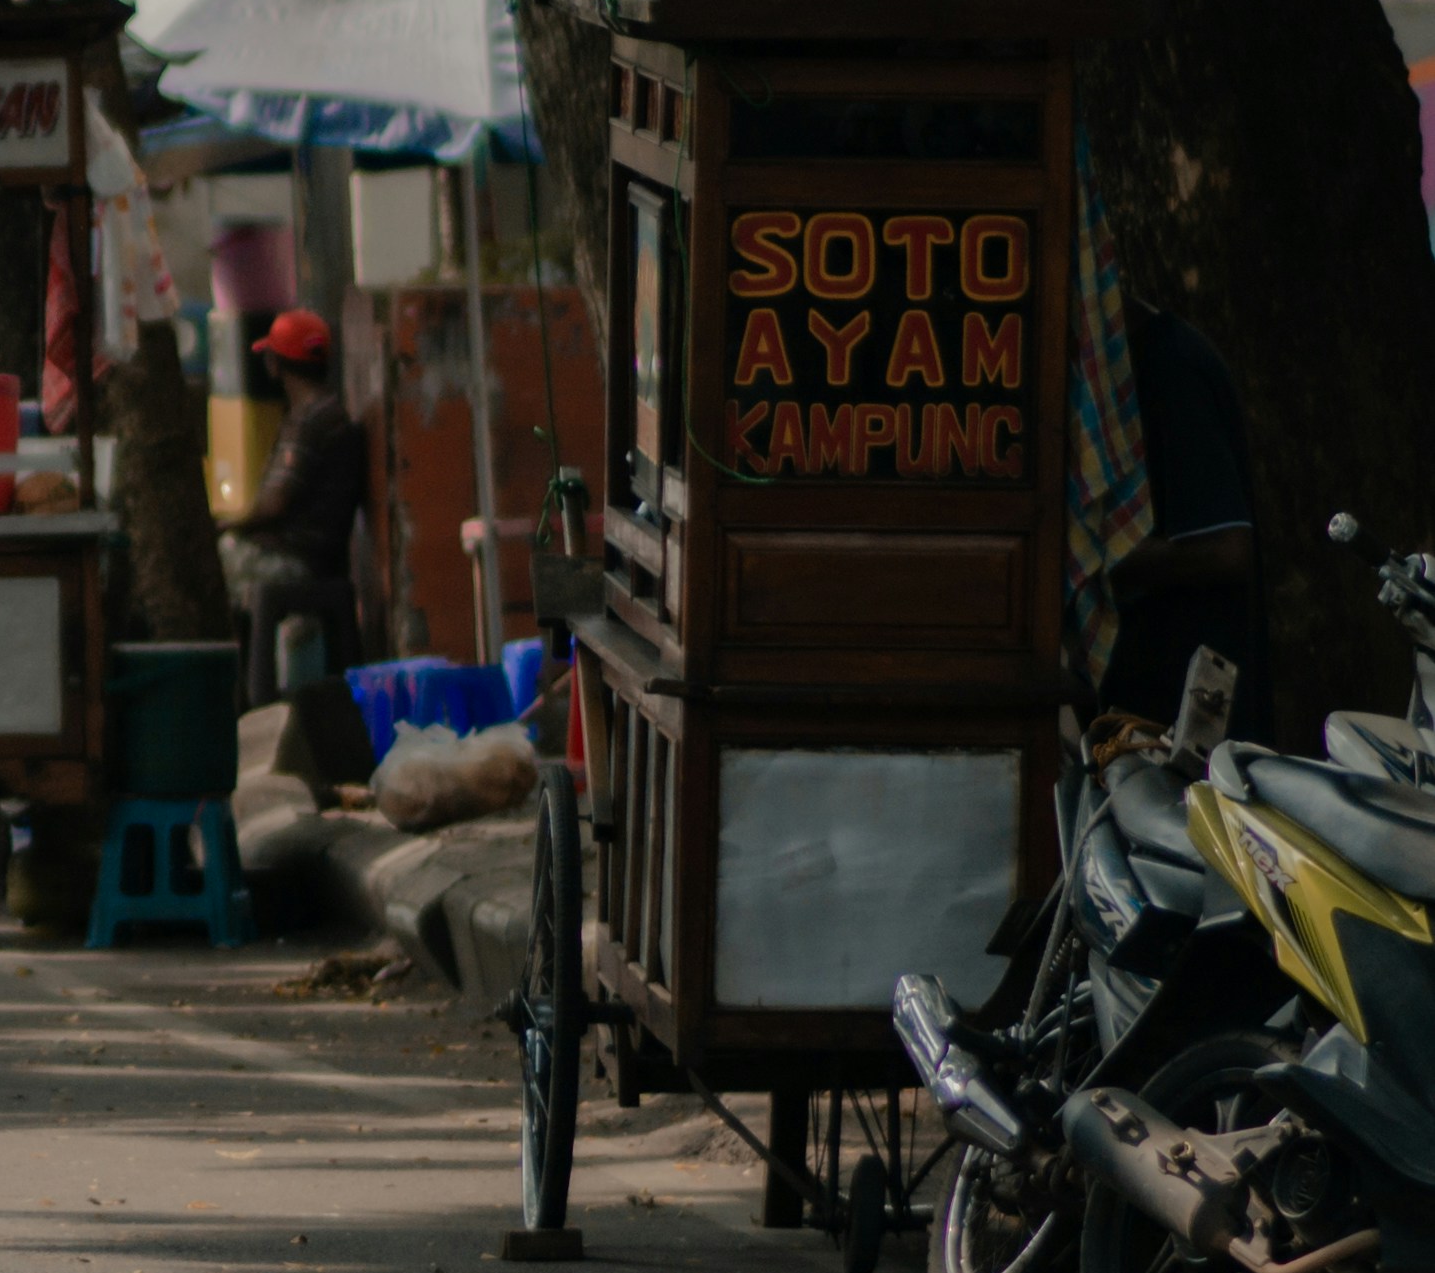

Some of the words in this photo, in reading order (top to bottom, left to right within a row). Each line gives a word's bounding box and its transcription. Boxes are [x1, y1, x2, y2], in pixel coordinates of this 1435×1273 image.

[728, 210, 1031, 303] SOTO
[733, 307, 1023, 389] AYAM
[725, 397, 1023, 479] KAMPUNG
